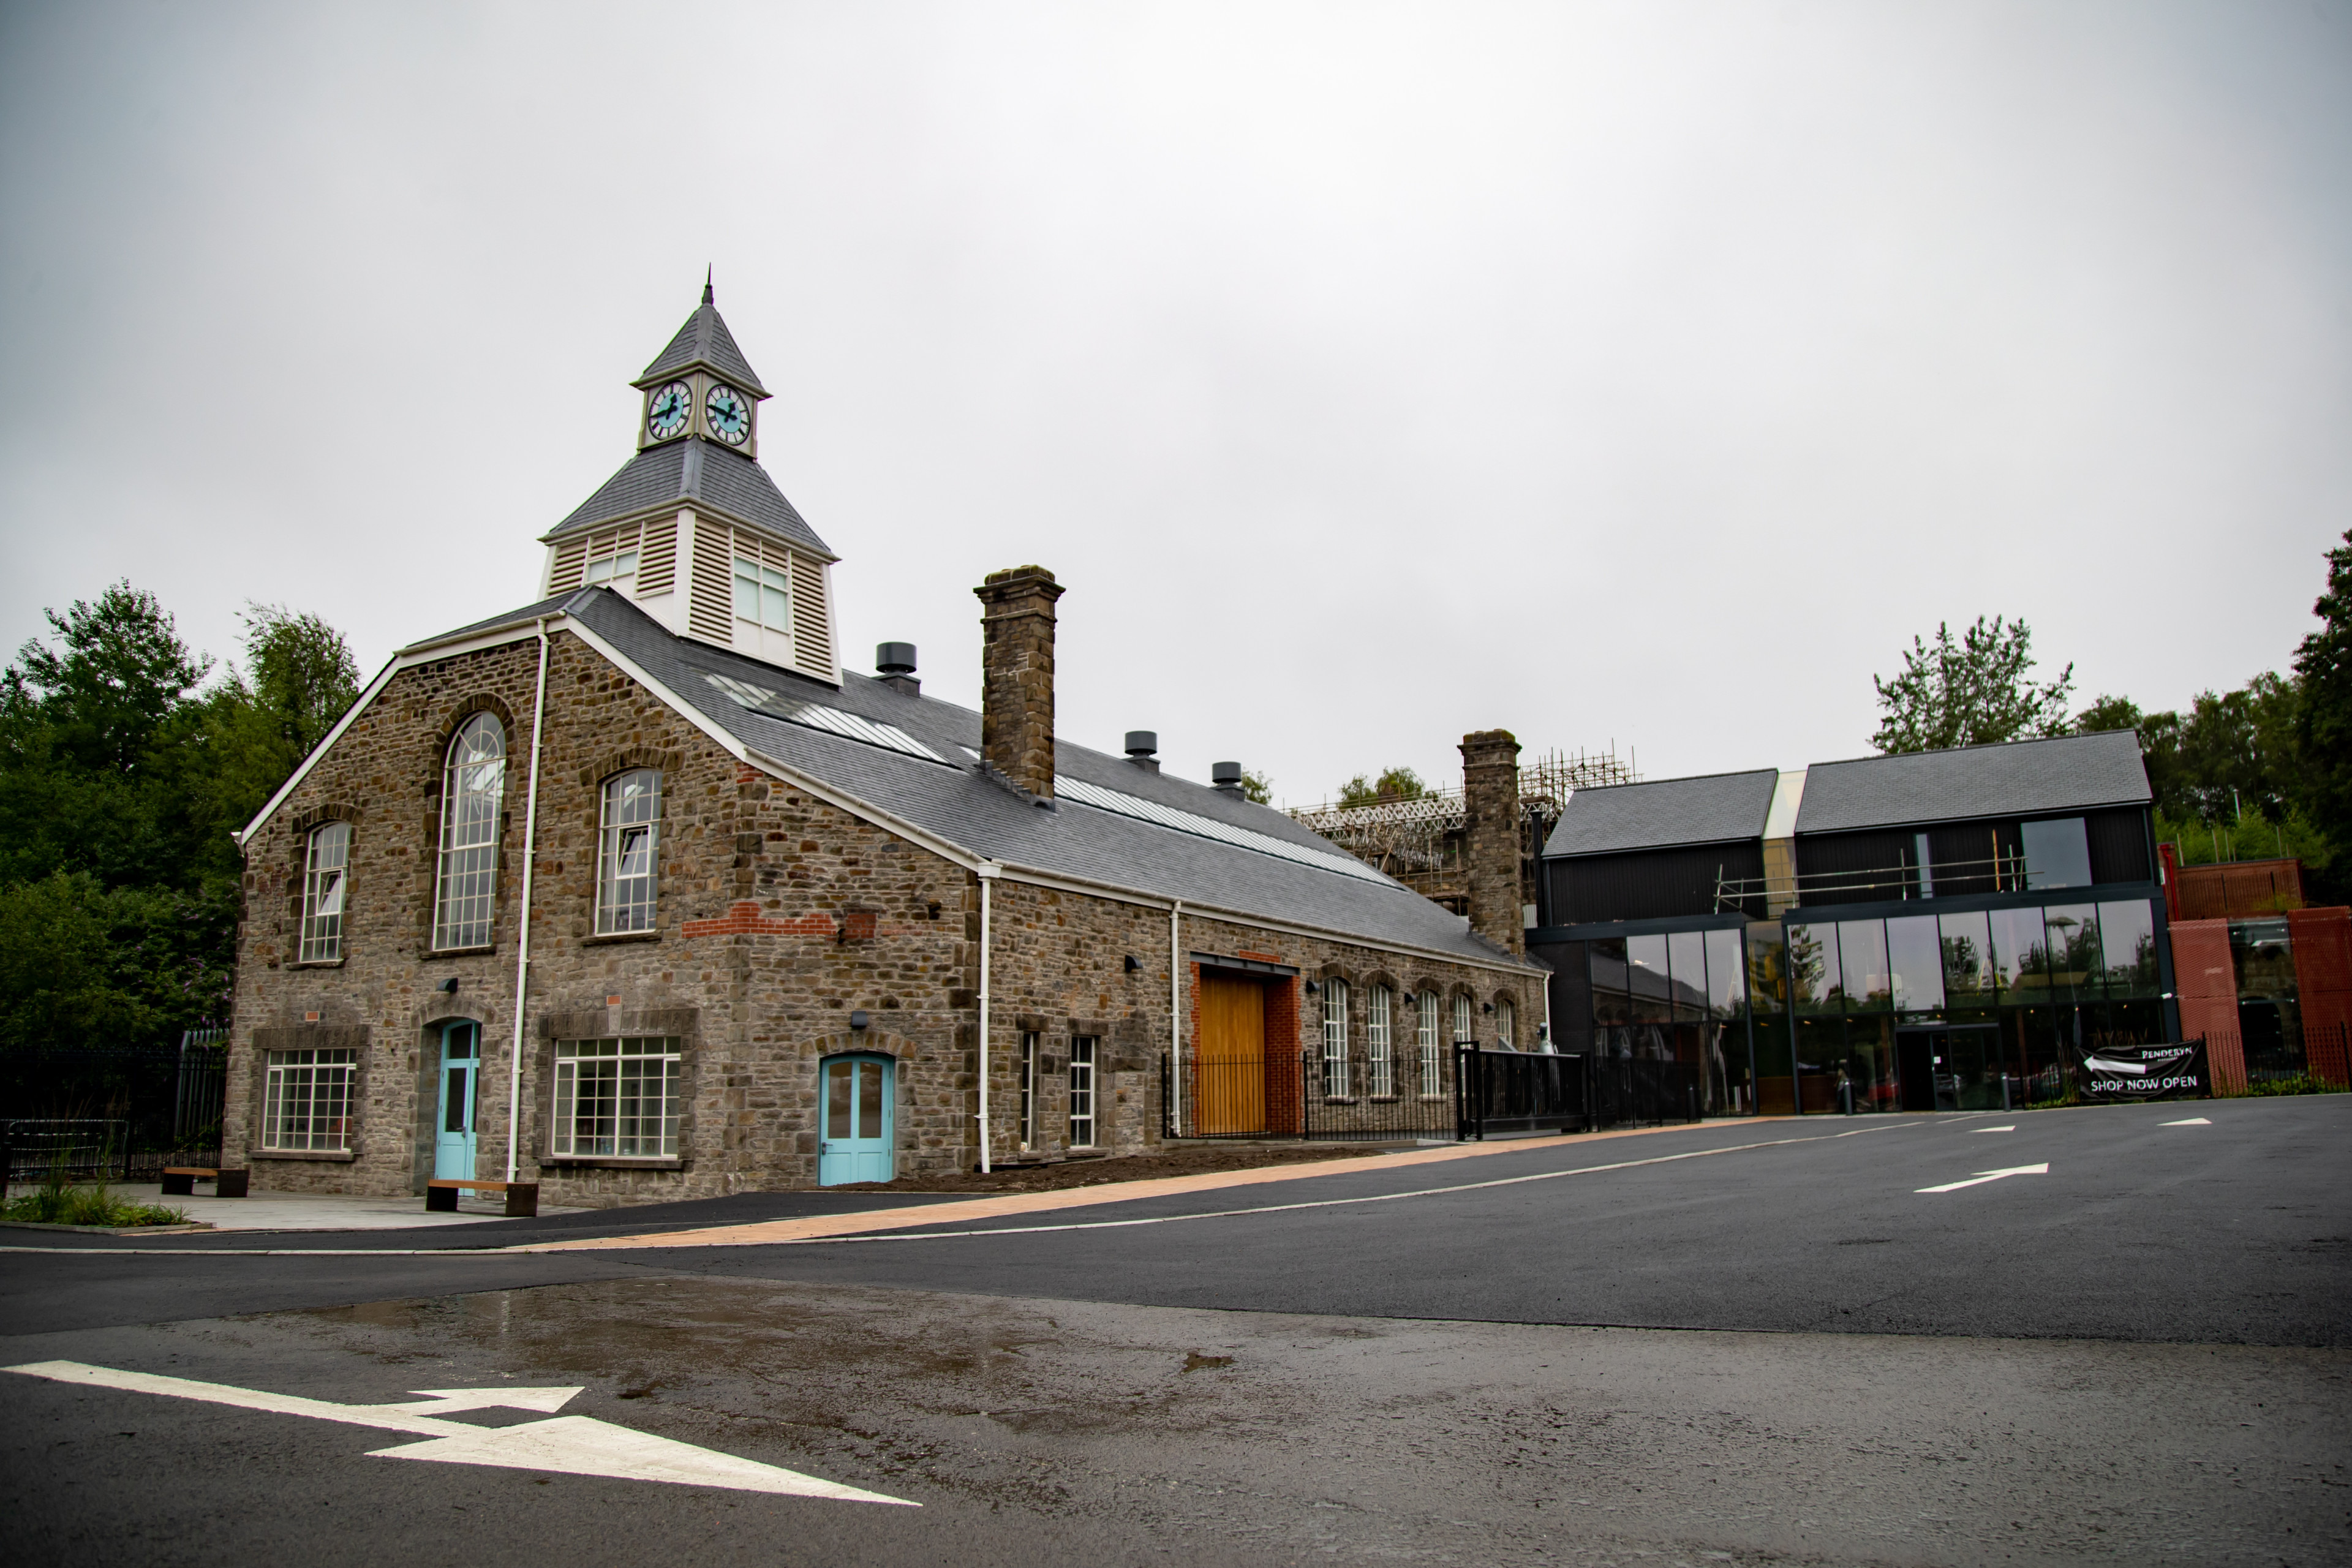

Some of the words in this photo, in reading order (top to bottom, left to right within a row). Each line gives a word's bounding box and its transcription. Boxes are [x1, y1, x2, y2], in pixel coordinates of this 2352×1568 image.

[2142, 1047, 2193, 1059] PENDERYN
[2091, 1080, 2124, 1091] SHOP
[2127, 1079, 2159, 1090] NOW
[2163, 1076, 2198, 1088] OPEN
